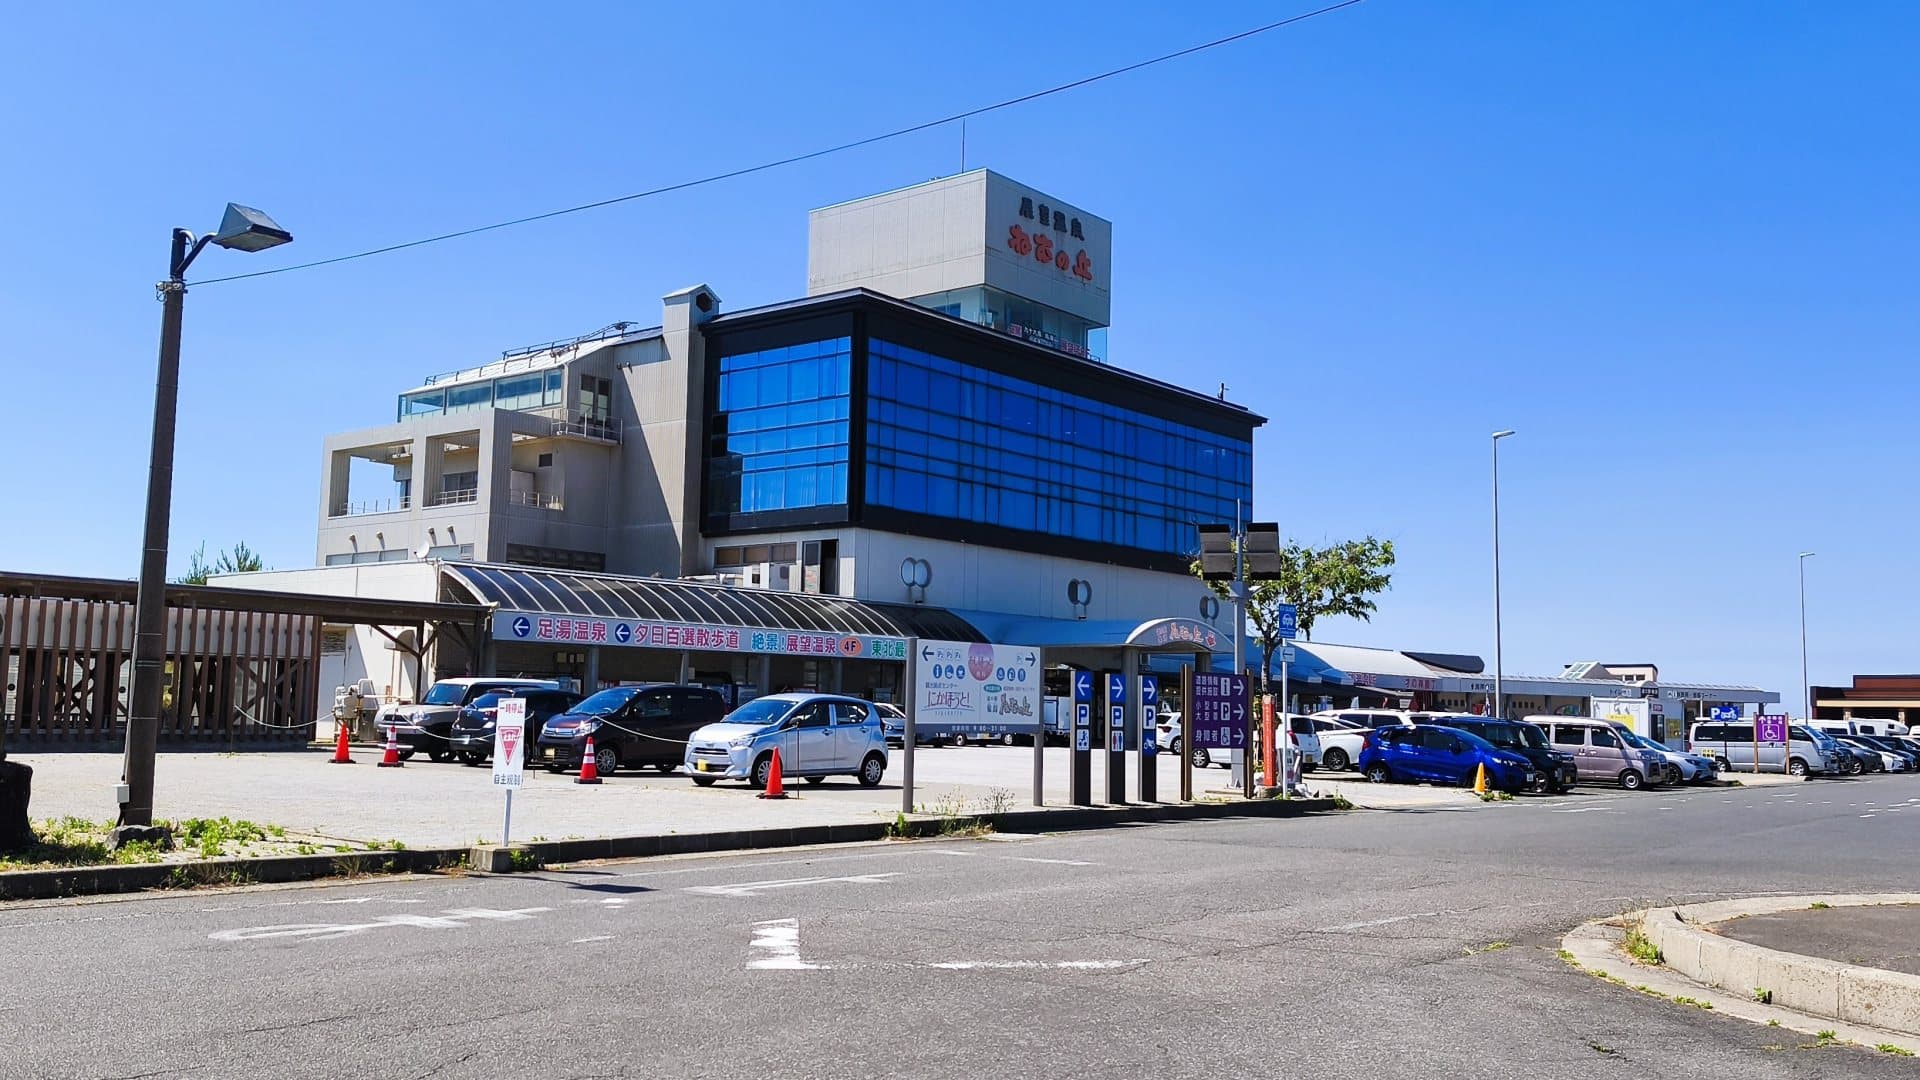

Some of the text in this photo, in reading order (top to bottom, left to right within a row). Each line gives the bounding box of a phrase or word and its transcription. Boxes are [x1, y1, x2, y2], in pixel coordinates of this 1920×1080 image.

[1008, 224, 1093, 281] ねむの丘
[536, 618, 607, 641] 足湯温泉
[634, 623, 740, 649] 夕日百選散歩道
[843, 641, 857, 653] 4F
[499, 703, 524, 714] 一時停止
[1711, 707, 1720, 719] P
[1195, 711, 1218, 721] 大型車
[1195, 729, 1218, 742] 身障者
